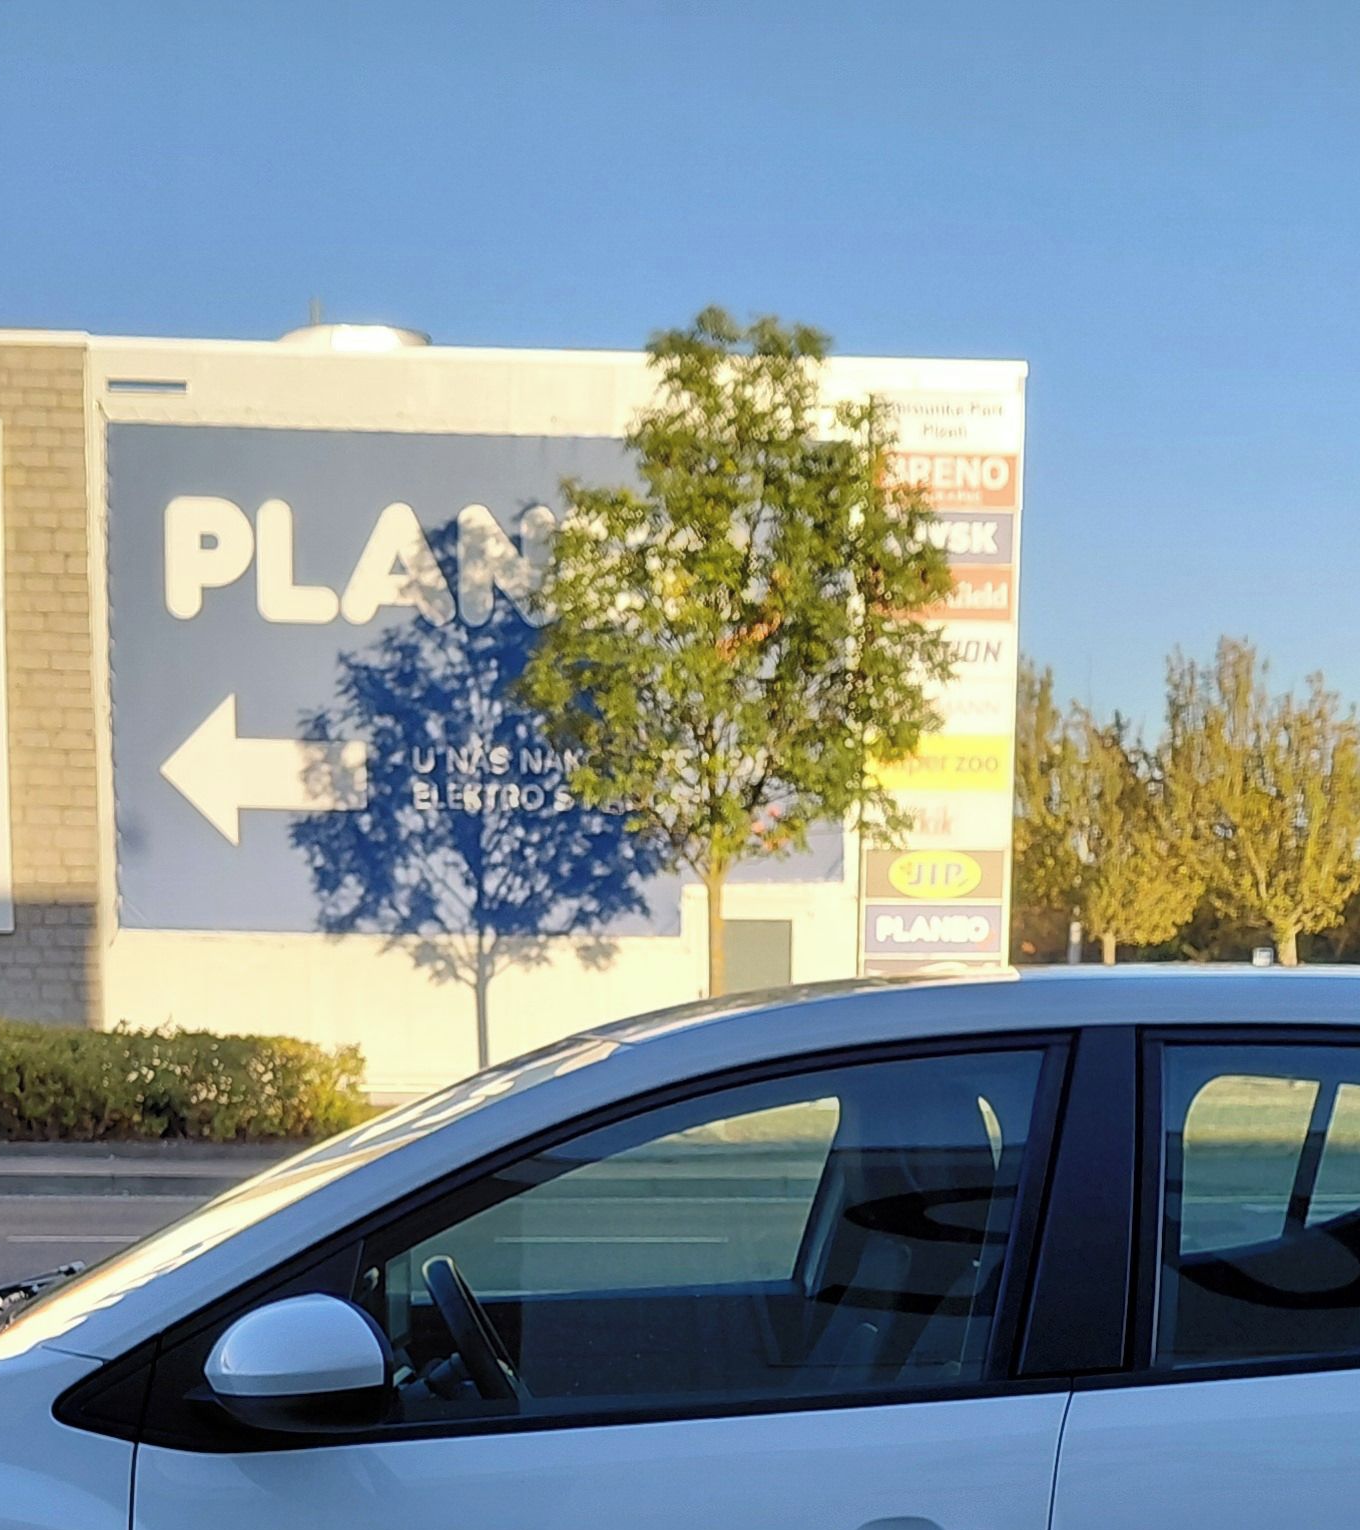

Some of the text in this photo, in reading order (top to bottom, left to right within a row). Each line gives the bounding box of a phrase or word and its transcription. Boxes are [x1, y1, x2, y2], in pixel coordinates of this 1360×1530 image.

[163, 494, 570, 626] PLAN
[411, 745, 435, 774] U
[411, 780, 544, 812] ELEKTRO
[875, 914, 990, 944] PLANEO
